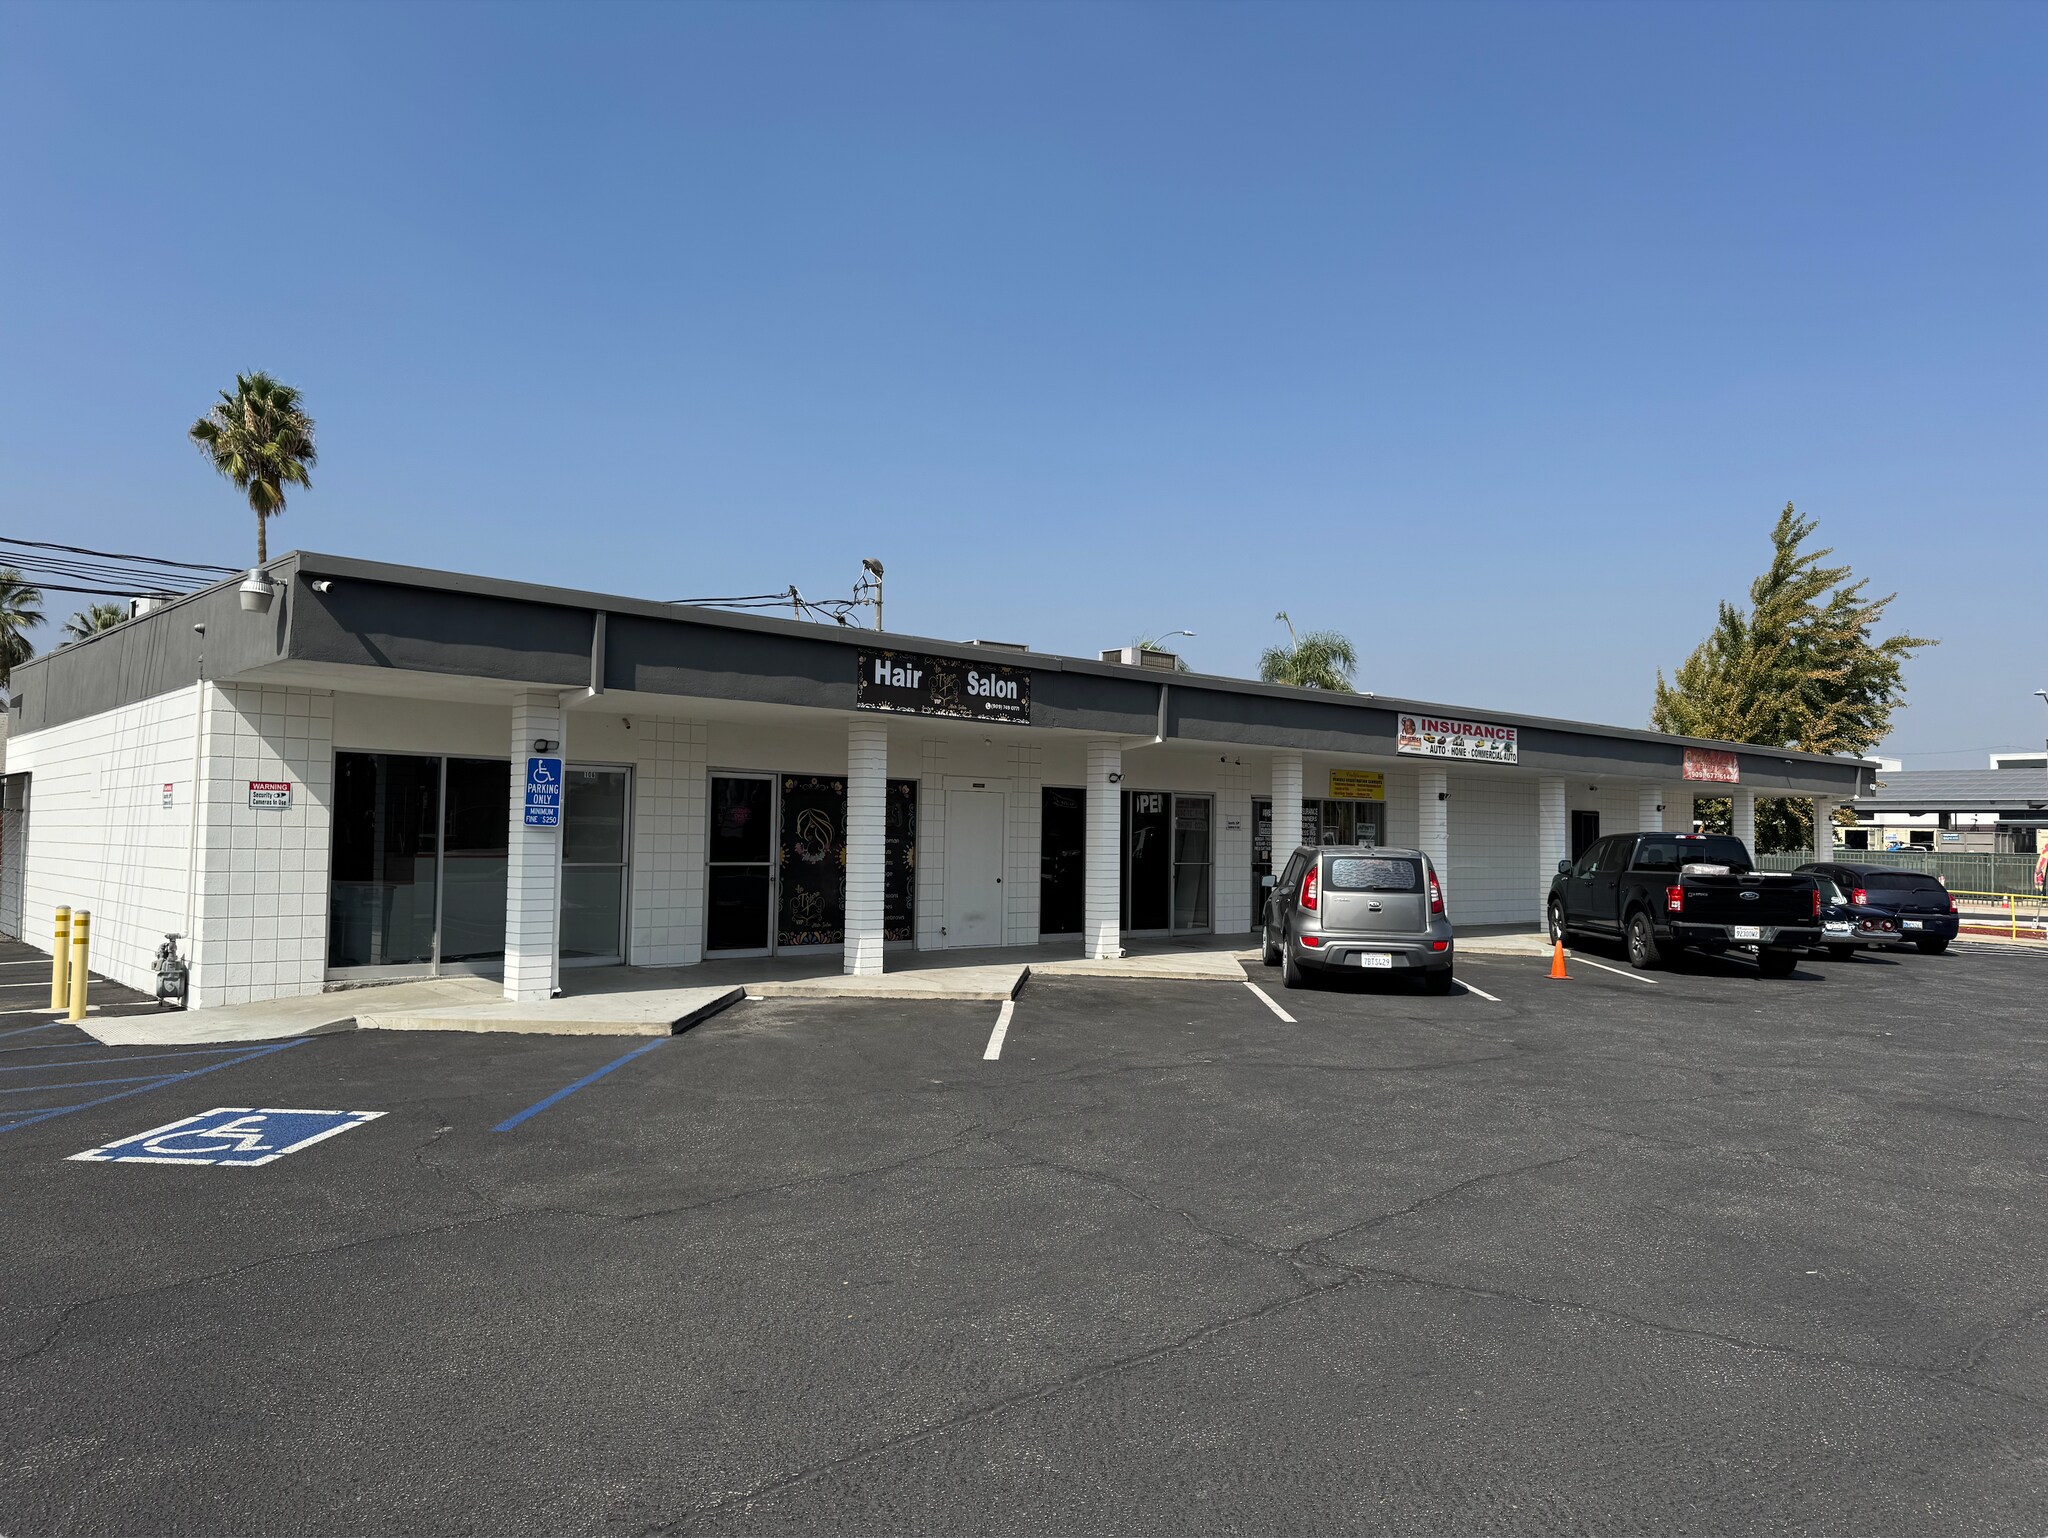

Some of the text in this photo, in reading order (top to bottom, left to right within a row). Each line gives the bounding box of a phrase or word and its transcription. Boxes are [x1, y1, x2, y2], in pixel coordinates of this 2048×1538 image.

[874, 659, 1018, 699] Hair Salon
[1421, 719, 1515, 741] INSURANCE
[1430, 745, 1516, 762] AUTO HOME COMMERCIAL AUTO
[528, 783, 559, 794] PARKING
[253, 791, 272, 799] Security
[533, 794, 552, 805] ONLY
[1137, 794, 1163, 813] PE
[530, 807, 554, 815] MINIMUM
[526, 815, 538, 823] FINE
